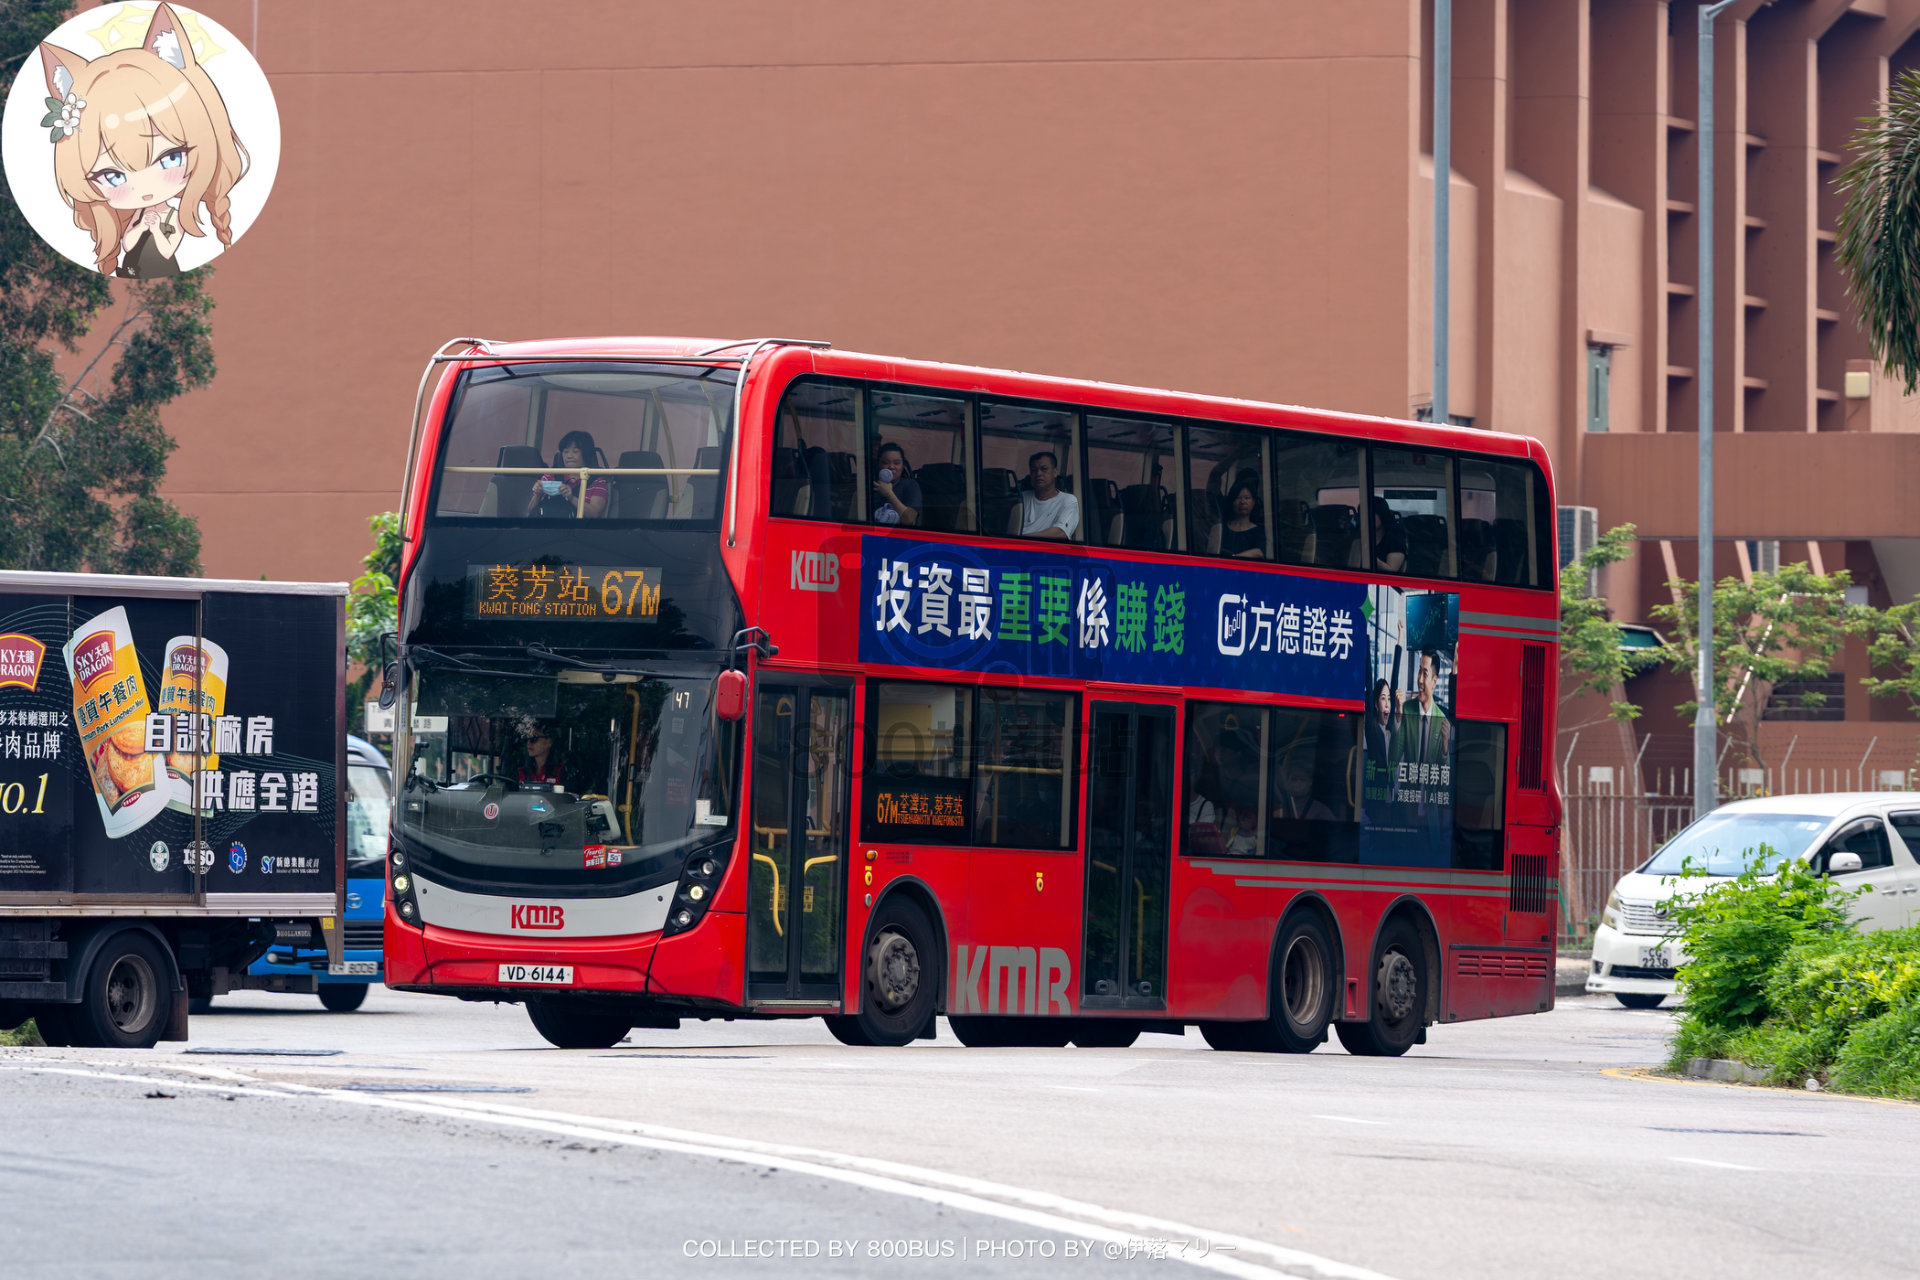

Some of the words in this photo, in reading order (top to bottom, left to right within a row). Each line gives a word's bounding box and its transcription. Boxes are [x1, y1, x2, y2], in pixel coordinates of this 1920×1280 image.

[790, 550, 839, 593] KMB
[488, 564, 590, 601] 葵芳站
[601, 570, 661, 616] 67M
[479, 602, 508, 615] KWAI
[511, 602, 541, 615] FONG
[544, 603, 597, 616] STATION
[876, 557, 1185, 656] 投資最重要係賺錢
[1250, 601, 1353, 660] 方德證券
[17, 650, 35, 664] 天龍
[75, 650, 94, 671] SKY
[94, 641, 111, 660] 天龍
[79, 653, 113, 681] DRAGON
[173, 653, 187, 664] SKY
[675, 691, 690, 709] 47
[96, 721, 110, 735] Pork
[109, 704, 136, 727] Luncheon
[877, 792, 898, 824] 67M
[511, 904, 565, 930] KMB
[507, 966, 526, 981] VD
[531, 966, 565, 982] 6144
[955, 944, 1072, 1016] KMB
